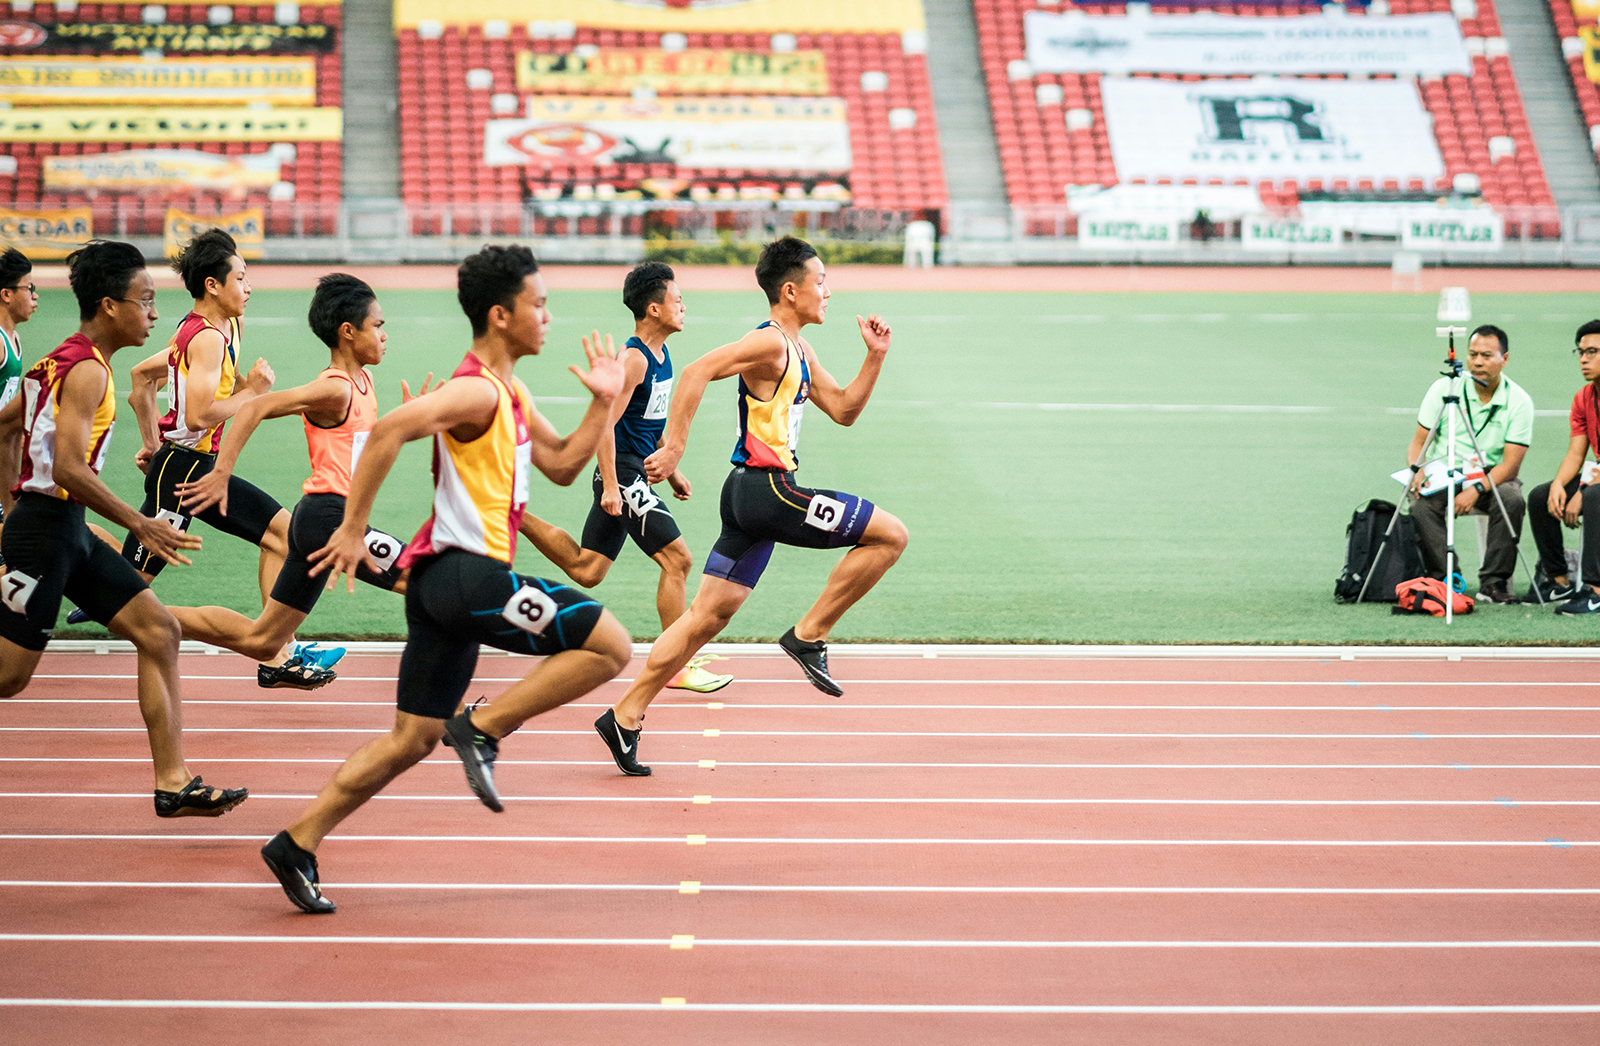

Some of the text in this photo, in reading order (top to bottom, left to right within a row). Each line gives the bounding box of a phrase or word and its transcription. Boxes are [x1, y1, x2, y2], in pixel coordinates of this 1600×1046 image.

[1188, 92, 1346, 145] R
[0, 218, 88, 237] CEDAR
[631, 489, 651, 509] 2
[813, 502, 836, 524] 5
[368, 539, 391, 559] 6
[8, 576, 27, 602] 7
[518, 597, 543, 622] 8
